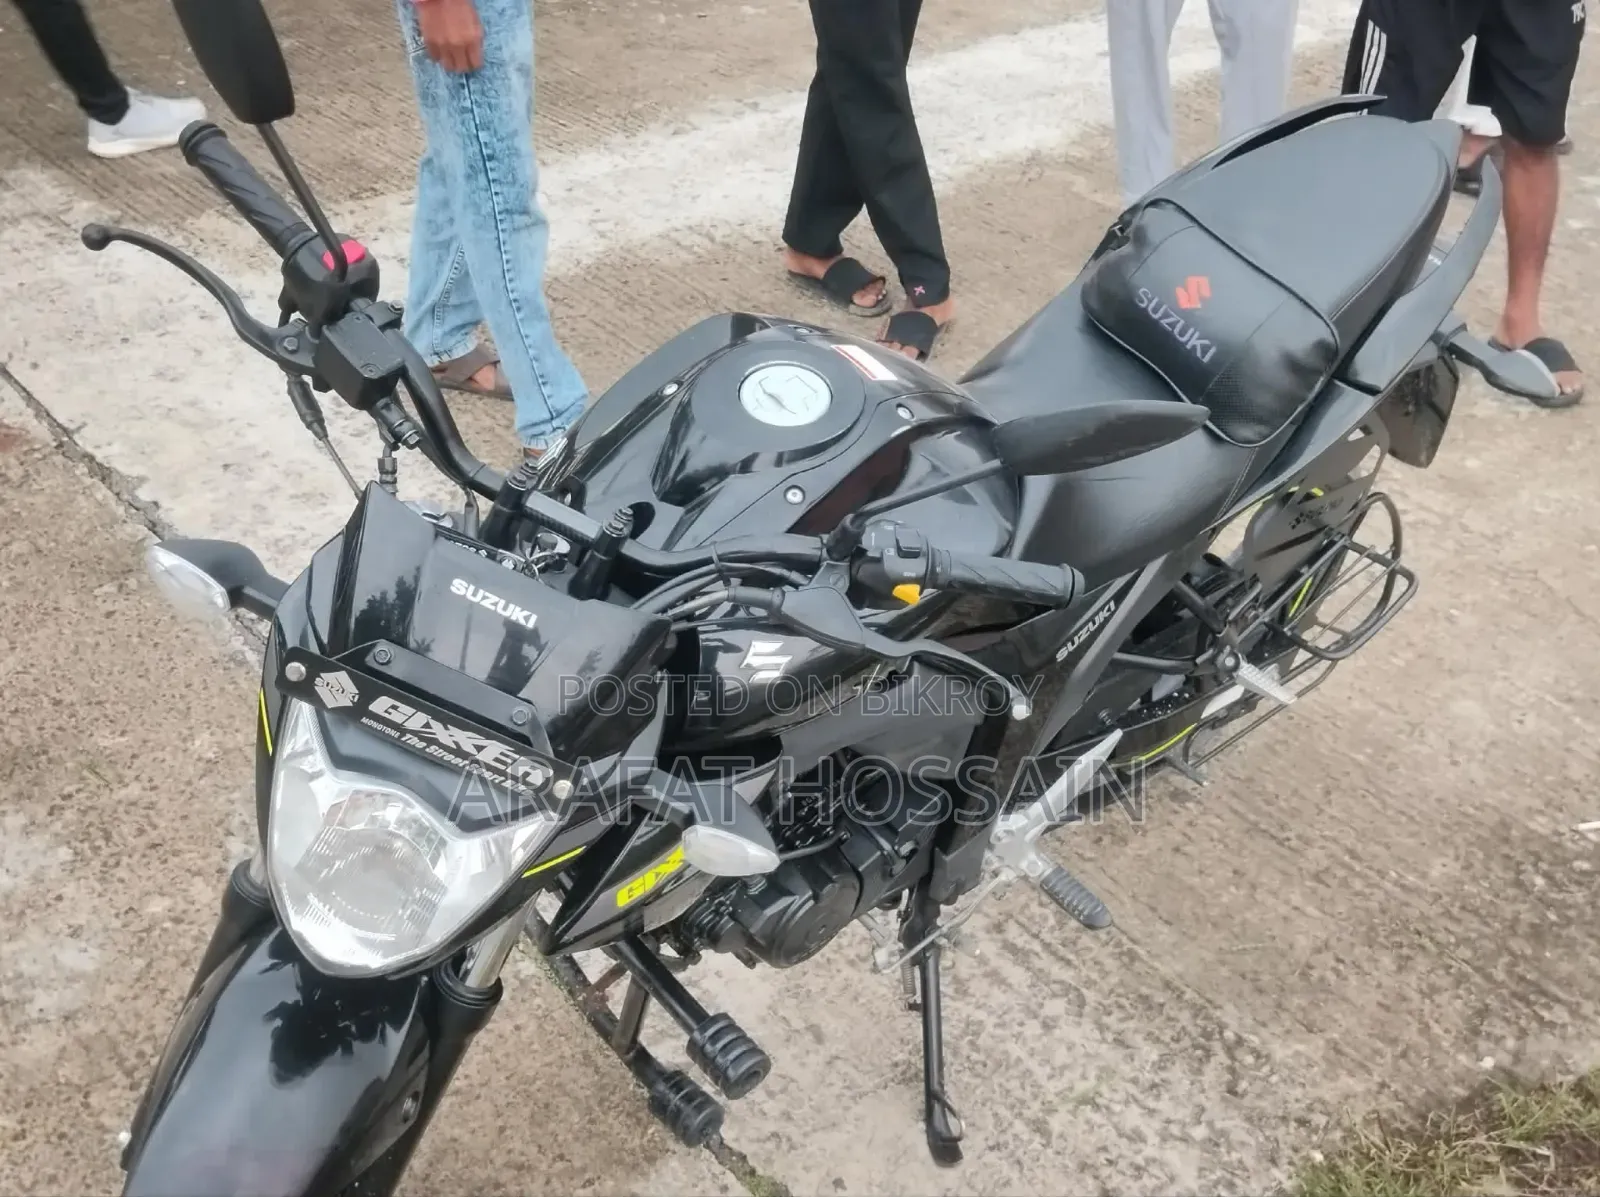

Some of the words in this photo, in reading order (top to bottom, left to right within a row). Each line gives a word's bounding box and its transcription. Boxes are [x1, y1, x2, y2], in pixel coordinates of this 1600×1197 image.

[1135, 287, 1217, 364] SUZUKI
[450, 578, 538, 628] SUZUKI
[1056, 600, 1116, 662] SUZUKI
[360, 716, 400, 739] MONOTONE
[400, 733, 427, 749] The
[425, 744, 468, 768] Street
[368, 695, 554, 786] GIXXER
